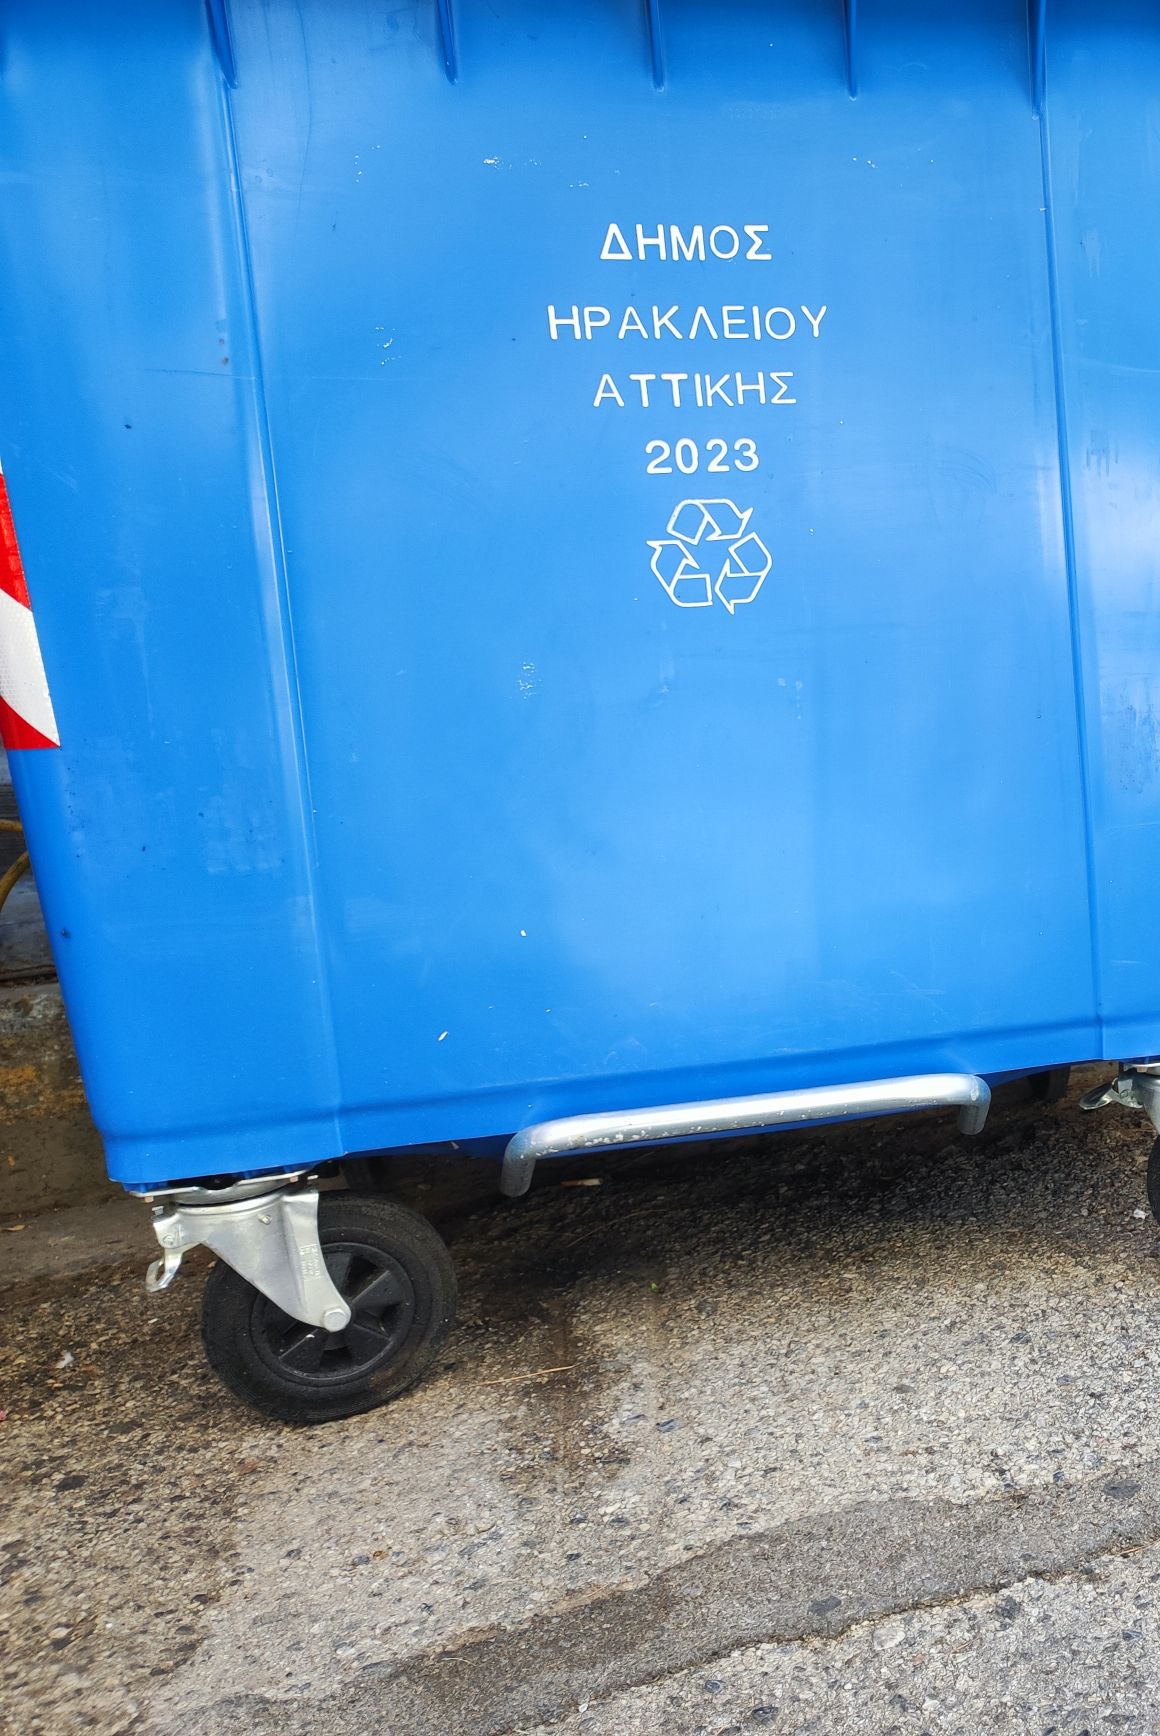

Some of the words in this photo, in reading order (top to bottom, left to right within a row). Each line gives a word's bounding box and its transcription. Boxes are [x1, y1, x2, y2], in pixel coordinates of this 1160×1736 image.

[600, 223, 772, 261] ΔΗΜΟΣ
[547, 304, 827, 341] ΗΡΑΚΛΕΙΟΥ
[593, 371, 797, 408] ΑΤΤΙΚΗΣ
[645, 437, 760, 475] 2023
